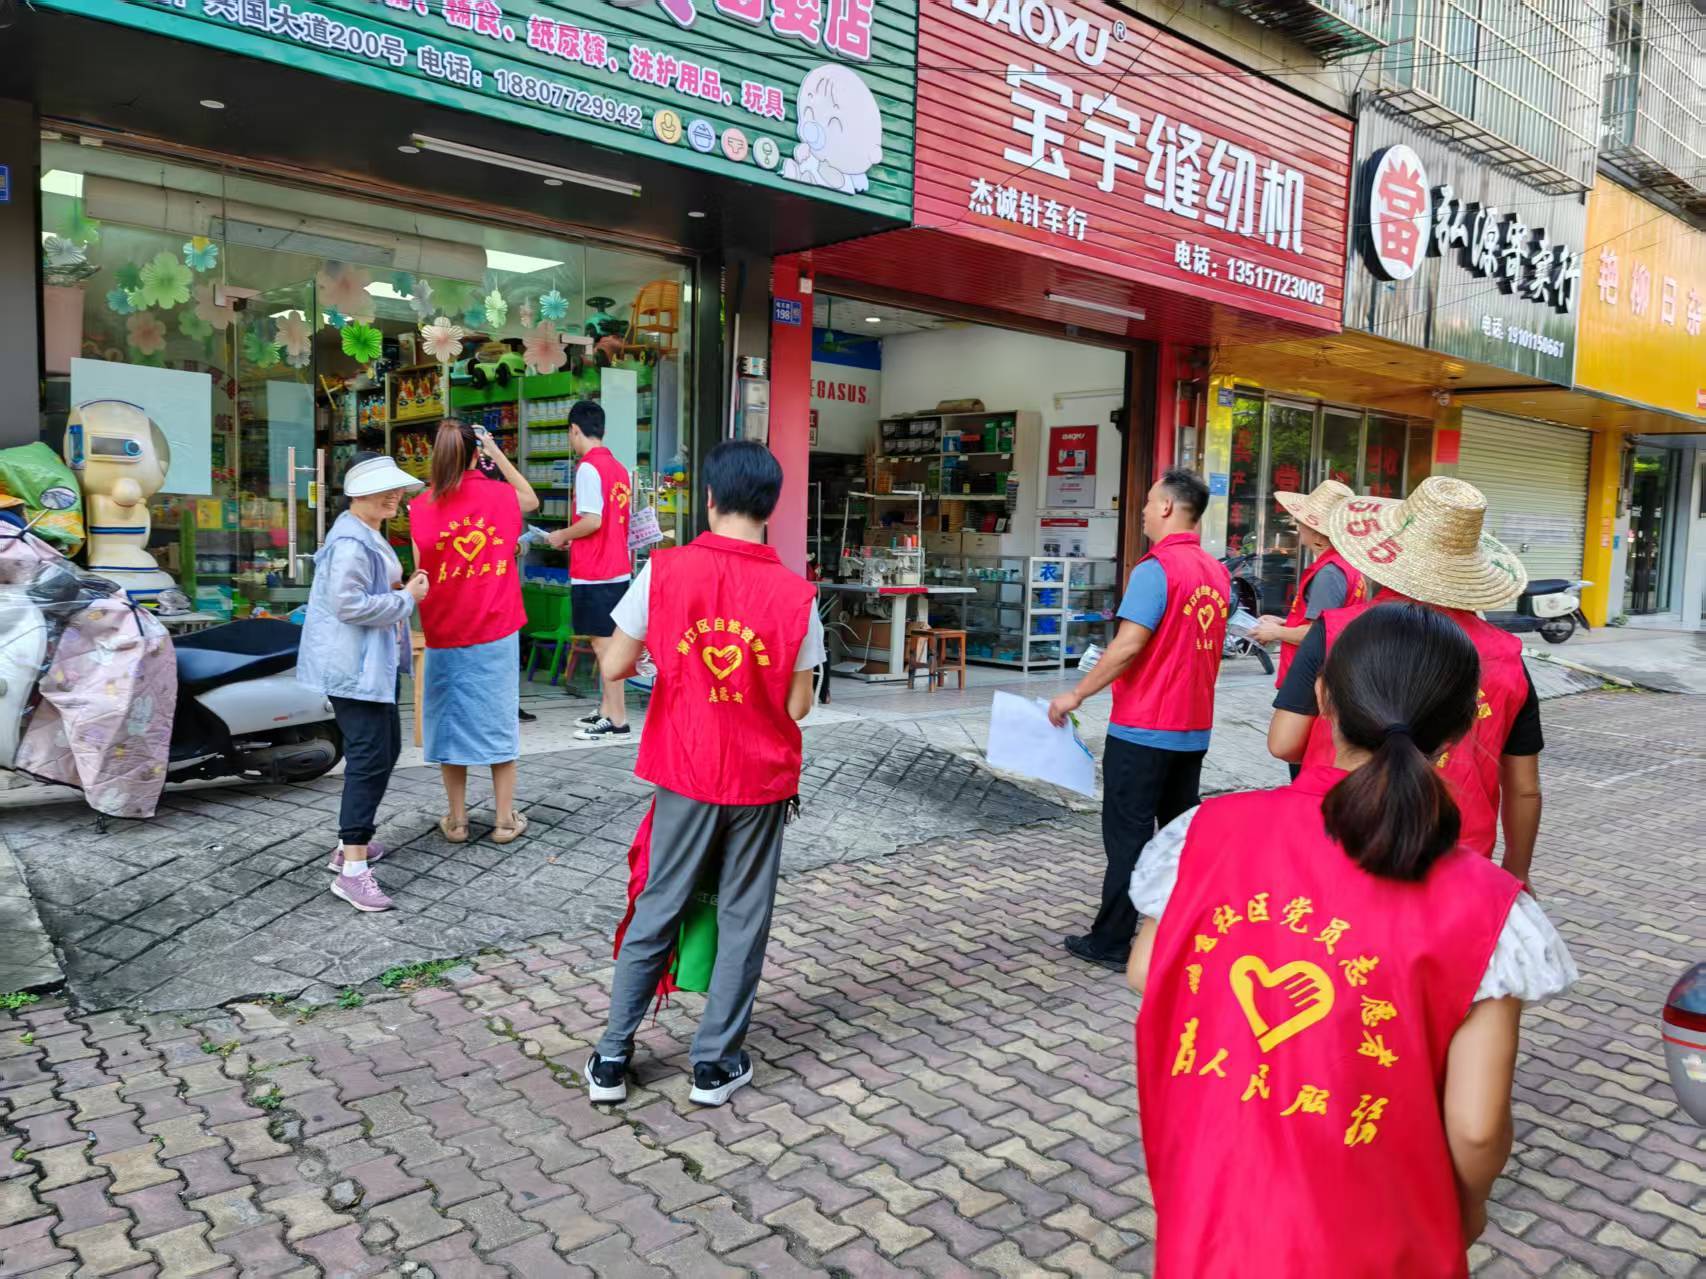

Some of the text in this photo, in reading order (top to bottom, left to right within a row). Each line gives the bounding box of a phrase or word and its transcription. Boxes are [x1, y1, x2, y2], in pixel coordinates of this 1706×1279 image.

[494, 70, 643, 129] 18807729942
[1003, 63, 1305, 255] 宝宇缝纫机
[968, 177, 1089, 242] 杰诚针车行
[1226, 258, 1325, 305] 13517723003
